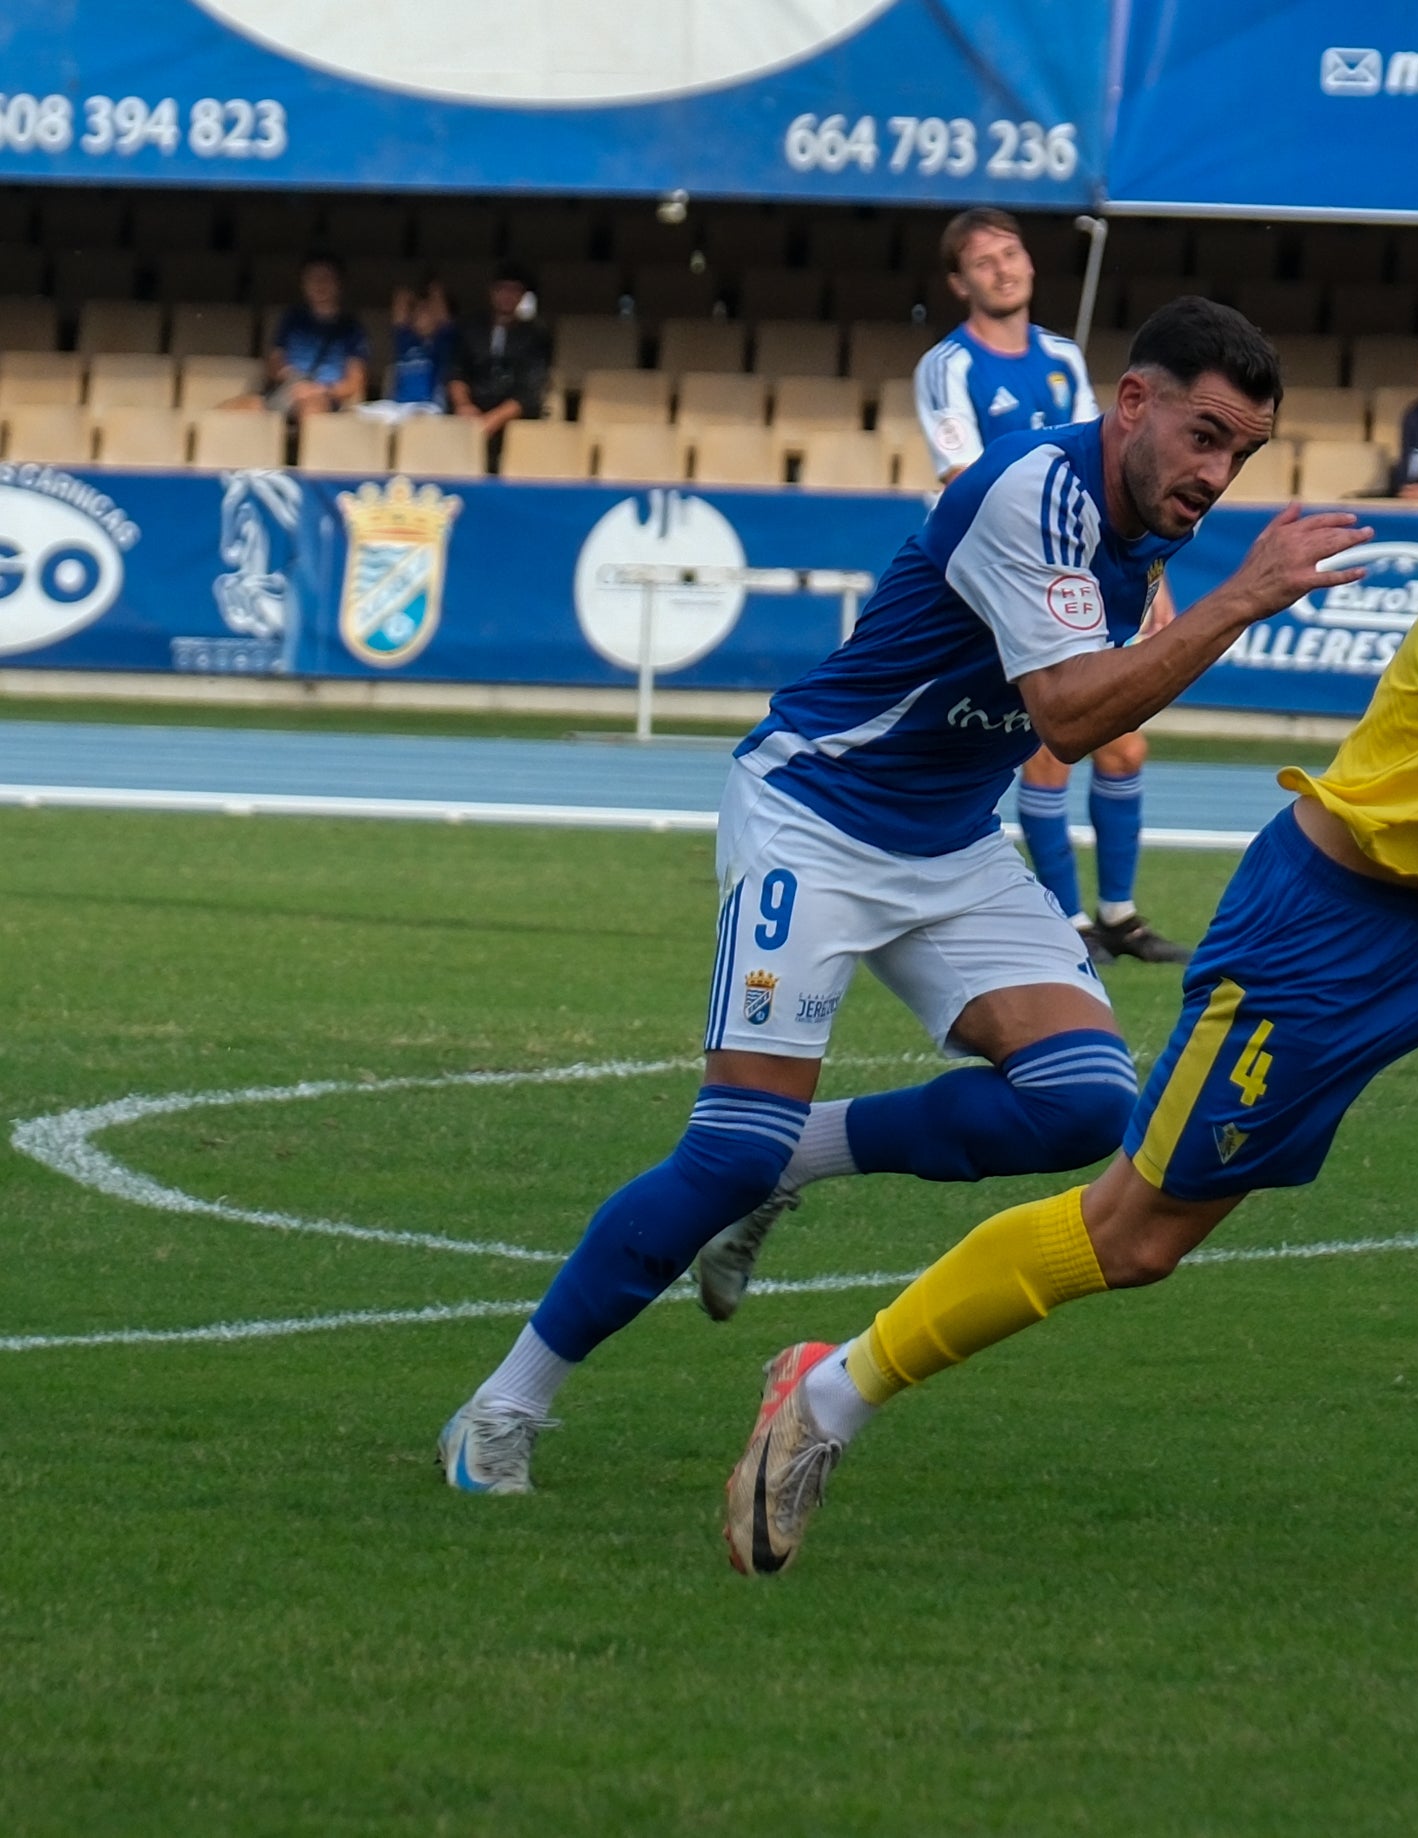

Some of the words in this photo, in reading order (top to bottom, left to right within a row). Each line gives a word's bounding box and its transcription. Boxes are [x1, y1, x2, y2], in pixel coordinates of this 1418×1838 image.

[0, 92, 73, 154] 08
[81, 94, 179, 156] 394
[189, 99, 288, 160] 823
[785, 113, 878, 174] 664
[888, 116, 977, 177] 793
[987, 119, 1078, 181] 236
[754, 868, 798, 950] 9
[1229, 1018, 1275, 1106] 4
